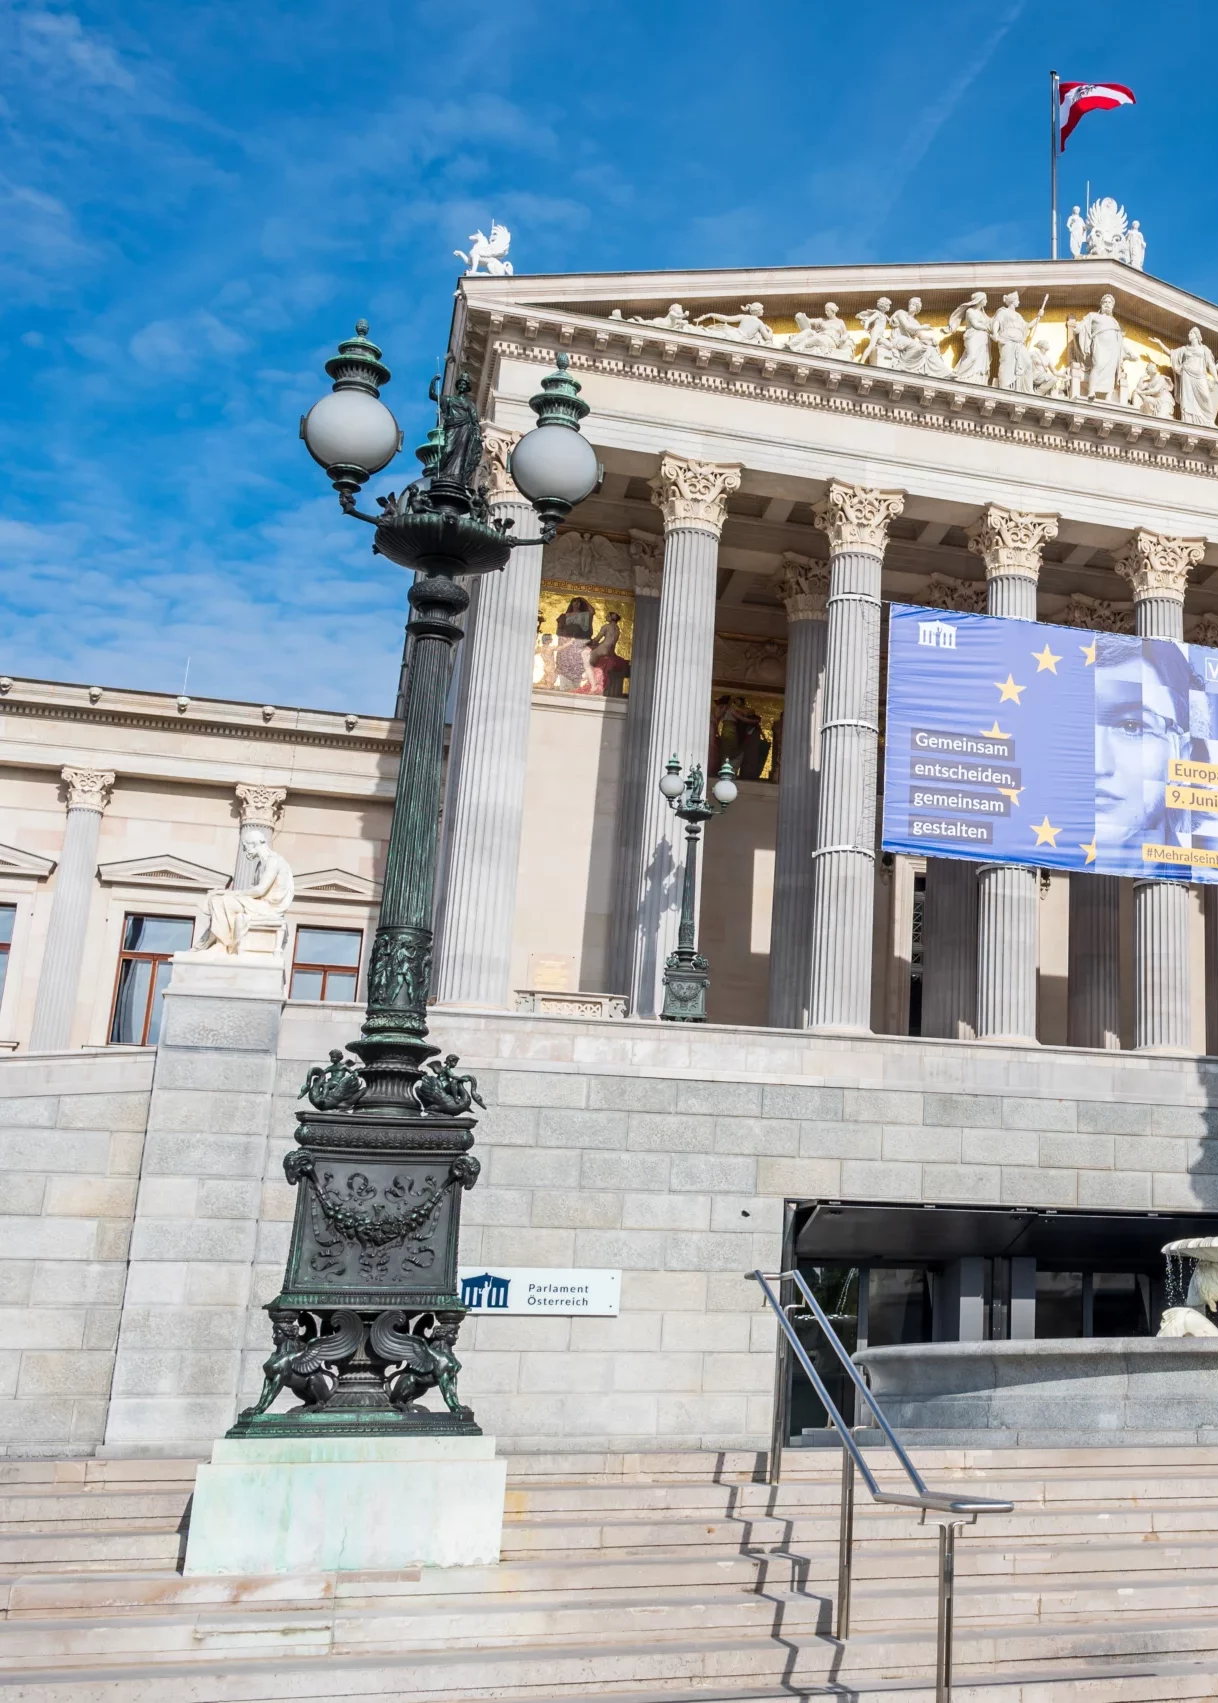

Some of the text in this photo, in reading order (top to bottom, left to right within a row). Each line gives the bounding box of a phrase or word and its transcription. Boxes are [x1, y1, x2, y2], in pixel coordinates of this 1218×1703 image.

[915, 732, 1008, 756] Gemeinsam
[914, 763, 1016, 787] entscheiden,
[913, 791, 1004, 813] gemeinsam
[1171, 790, 1185, 804] 9.
[1189, 793, 1218, 808] Juni
[912, 820, 987, 839] gestalten
[528, 1283, 589, 1293] Parlament
[527, 1295, 588, 1306] Österreich
